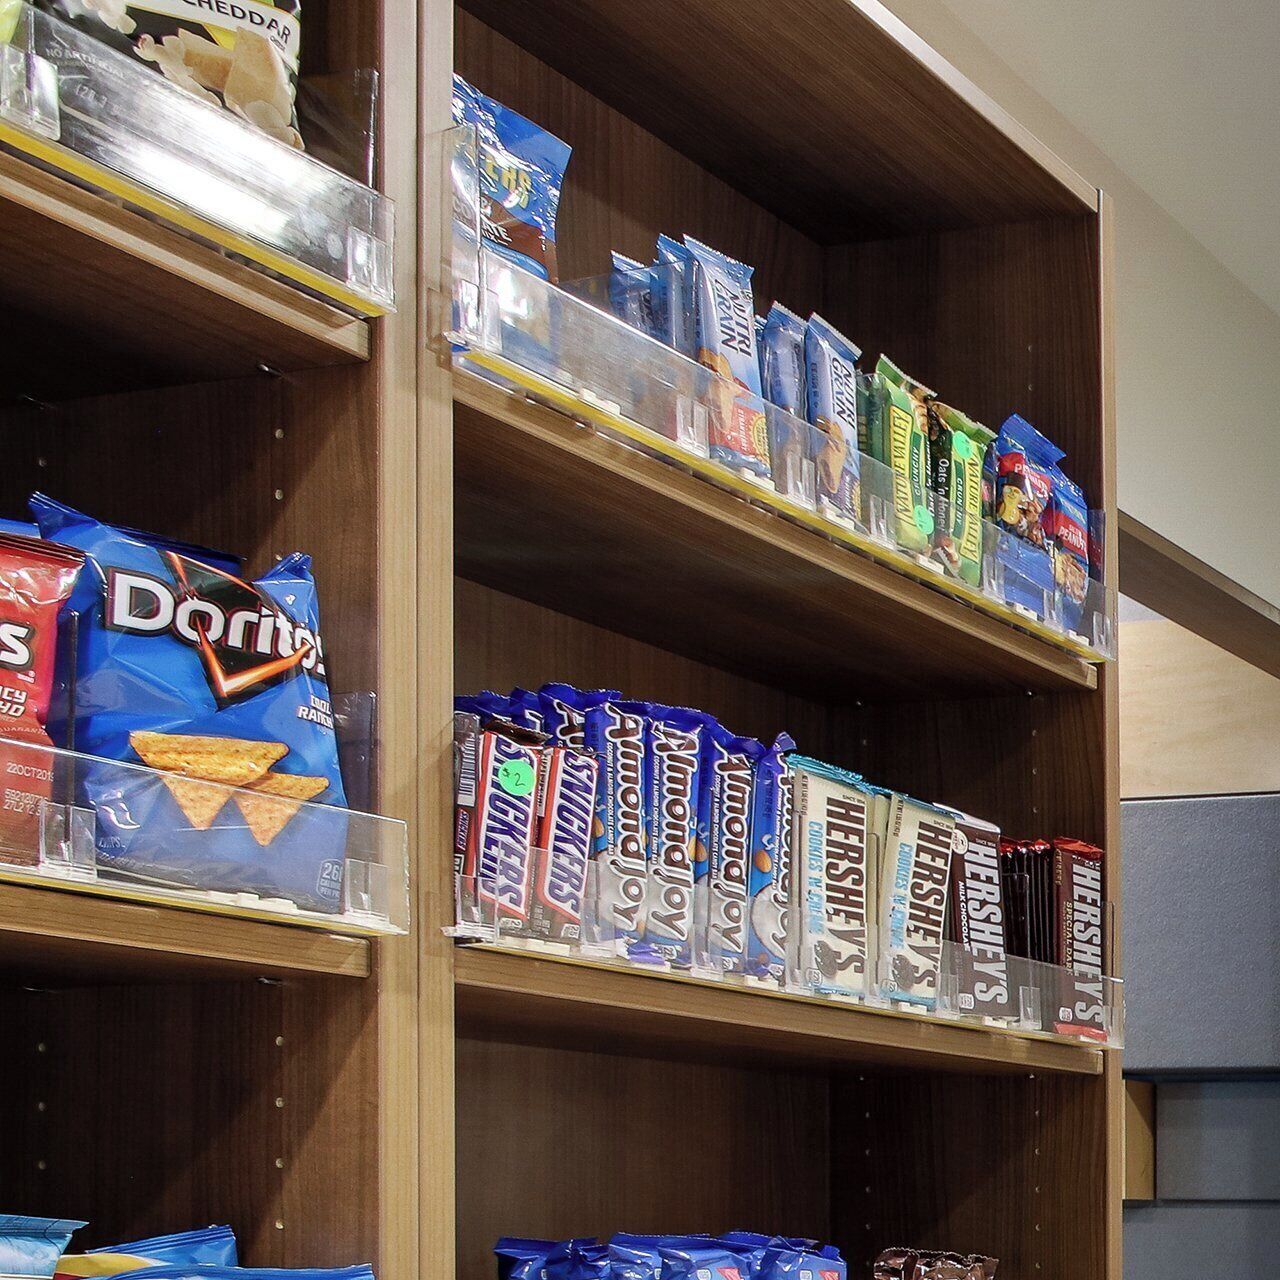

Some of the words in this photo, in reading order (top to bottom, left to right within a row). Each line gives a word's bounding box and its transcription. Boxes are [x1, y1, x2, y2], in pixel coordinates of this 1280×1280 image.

[184, 0, 293, 45] HEDDAR
[714, 278, 739, 354] GRAIN
[725, 284, 753, 357] NUTRI
[891, 409, 911, 462] VALLEY
[938, 457, 950, 482] Oats
[894, 463, 912, 517] NATURE
[967, 456, 980, 512] NATURE
[109, 571, 326, 674] Doritos
[604, 703, 645, 861] Almond
[652, 722, 700, 868] Almond
[713, 739, 752, 890] Almond
[548, 749, 599, 915] SNICKERS
[609, 856, 646, 932] Joy
[650, 866, 693, 941] Joy
[711, 881, 747, 953] Joy
[825, 795, 867, 975] HERSHEY'S
[905, 820, 955, 989] HERSHEY'S
[963, 841, 1009, 1005] HERSHEY'S
[1071, 863, 1103, 1023] HERSHEY'S
